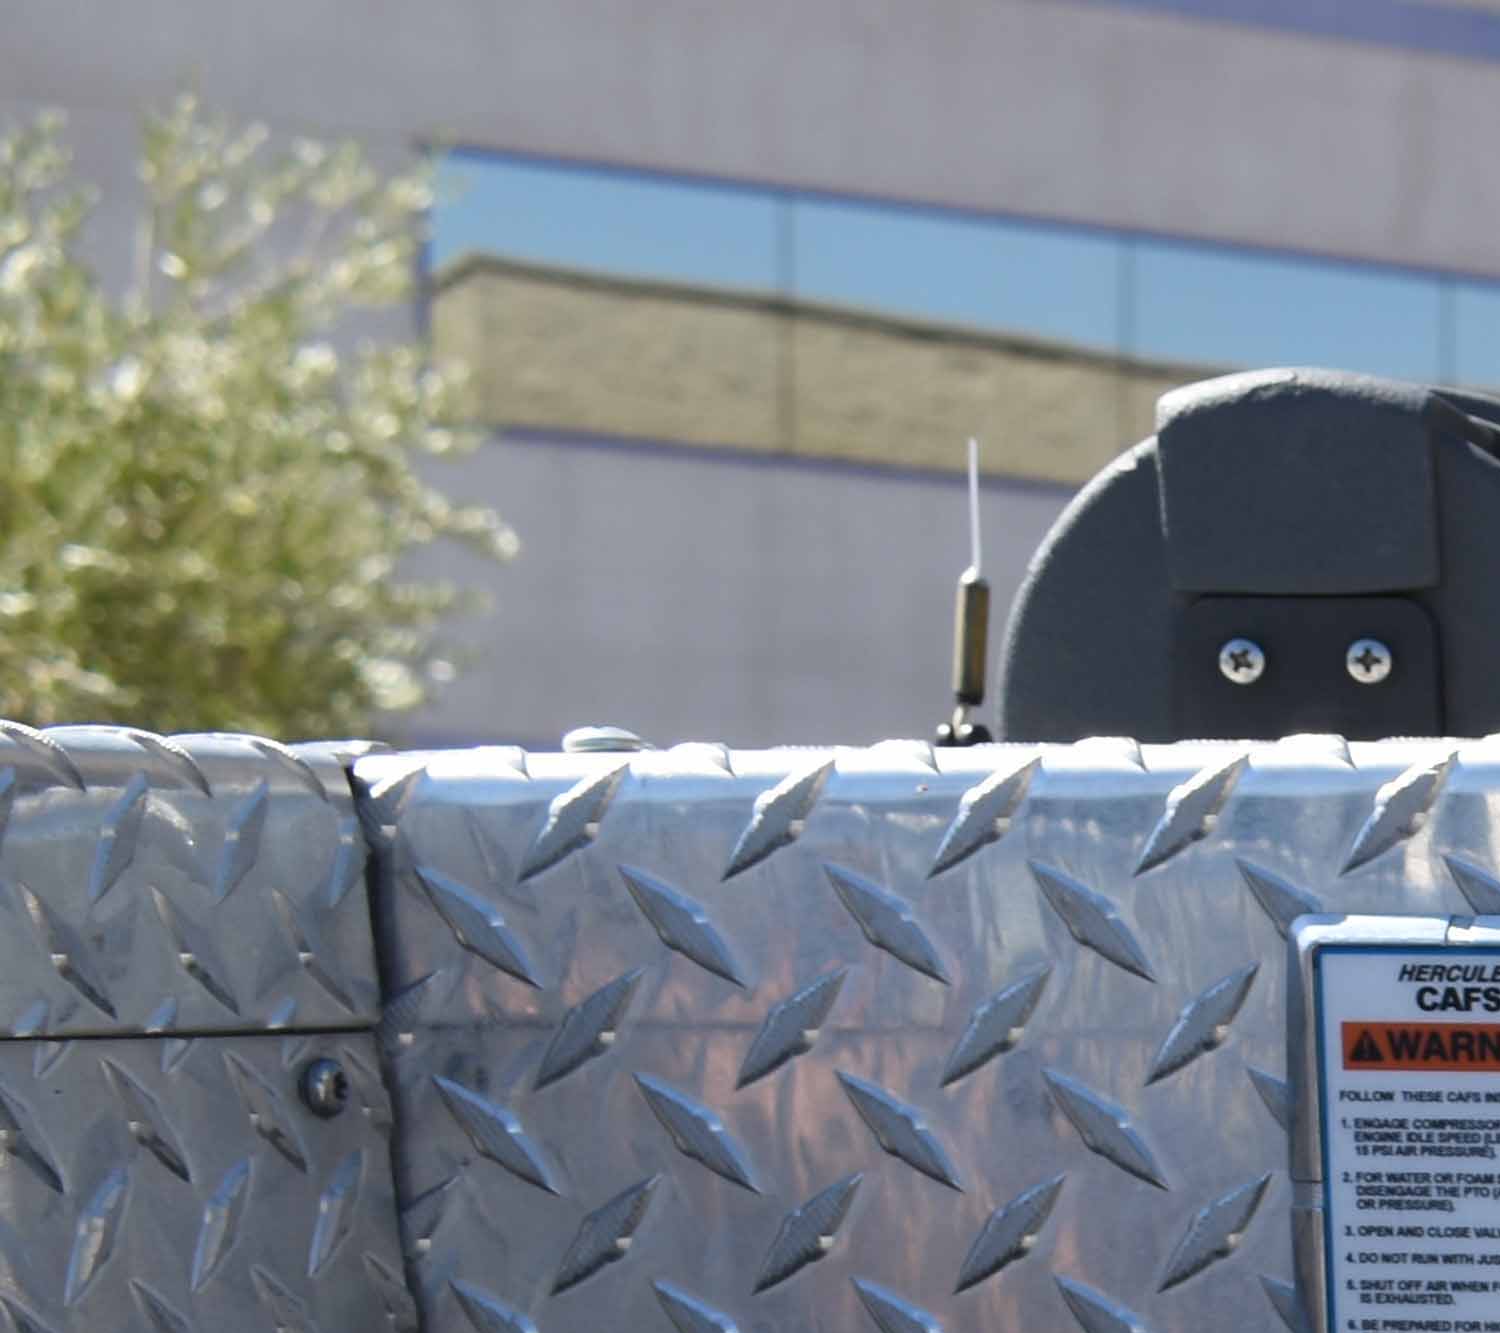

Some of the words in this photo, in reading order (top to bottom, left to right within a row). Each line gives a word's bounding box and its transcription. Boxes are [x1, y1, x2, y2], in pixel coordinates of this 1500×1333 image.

[1339, 1090, 1395, 1102] FOLLOW
[1402, 1091, 1443, 1103] THESE
[1446, 1091, 1482, 1103] CAFS
